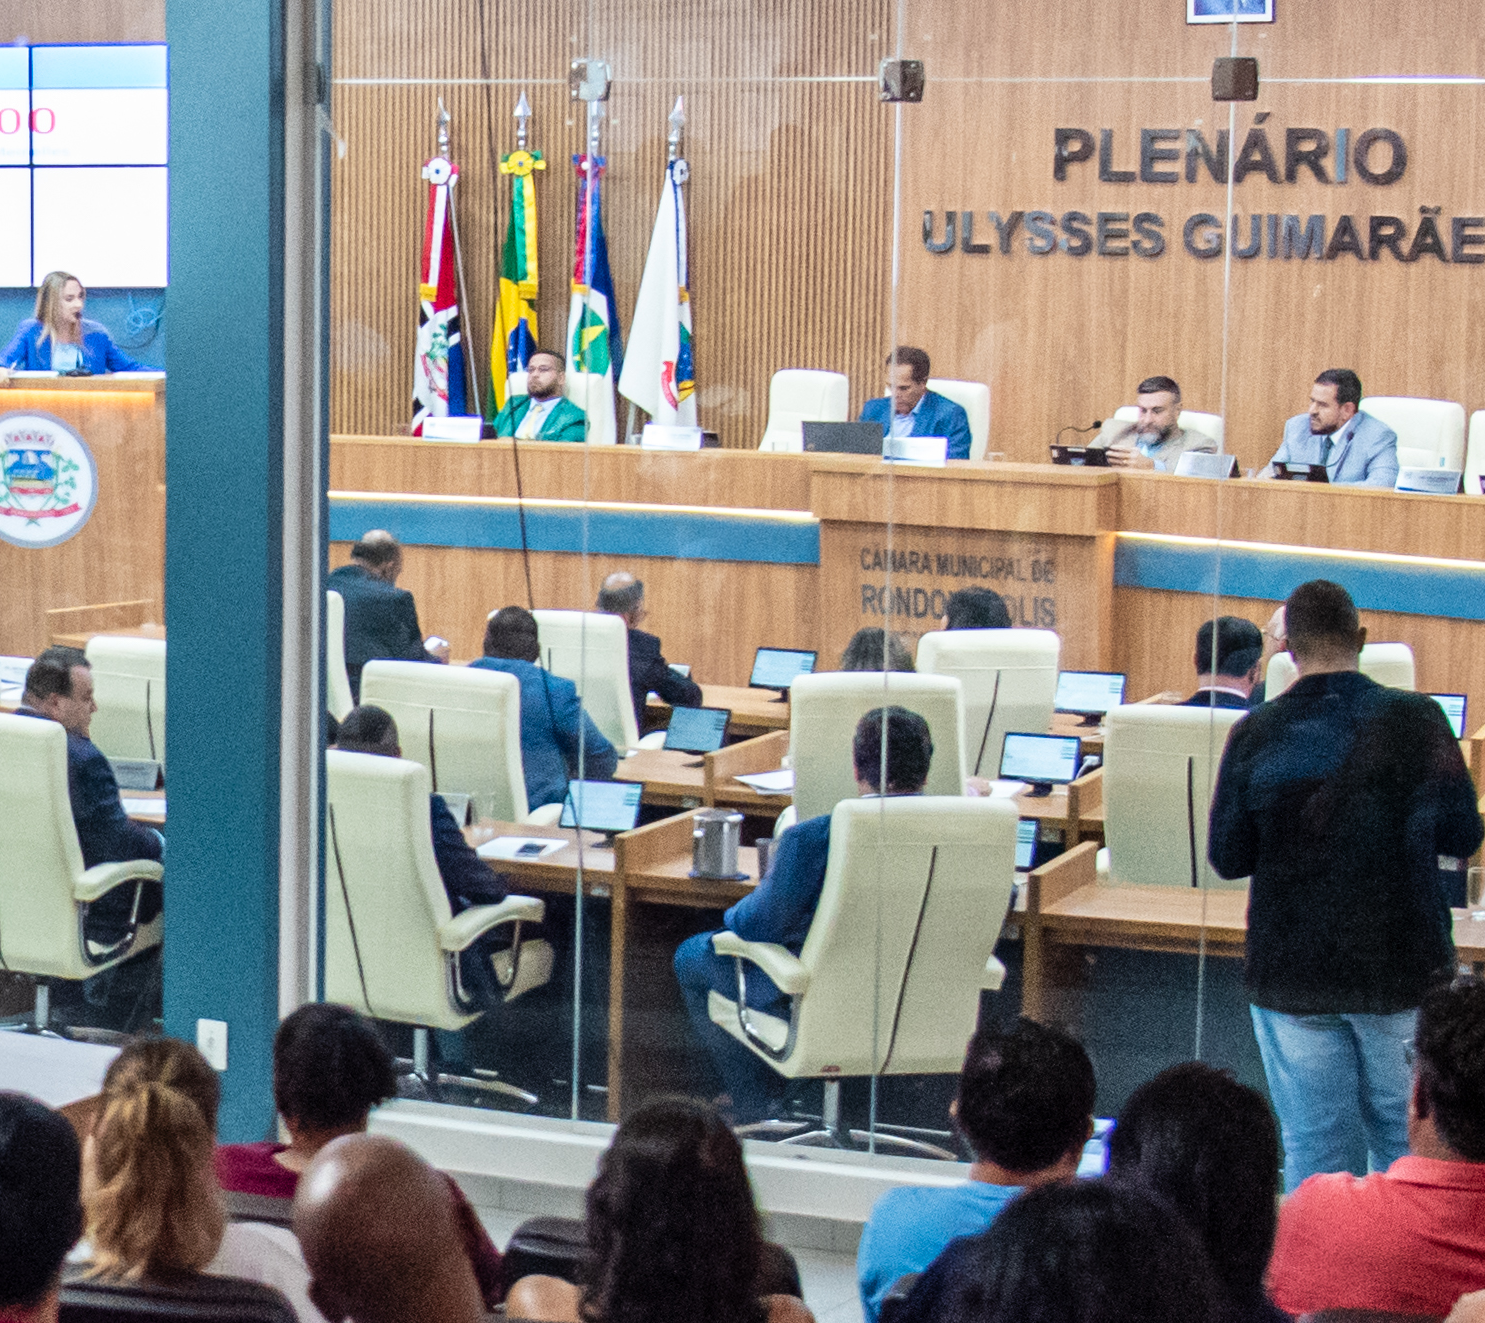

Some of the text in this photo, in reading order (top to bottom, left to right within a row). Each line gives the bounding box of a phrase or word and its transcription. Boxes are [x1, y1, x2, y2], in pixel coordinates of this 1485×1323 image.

[1053, 112, 1408, 187] PLENÁRIO
[923, 209, 1166, 258] ULYSSES
[935, 551, 1026, 582] MUNICIPAL
[1031, 557, 1056, 585] DE
